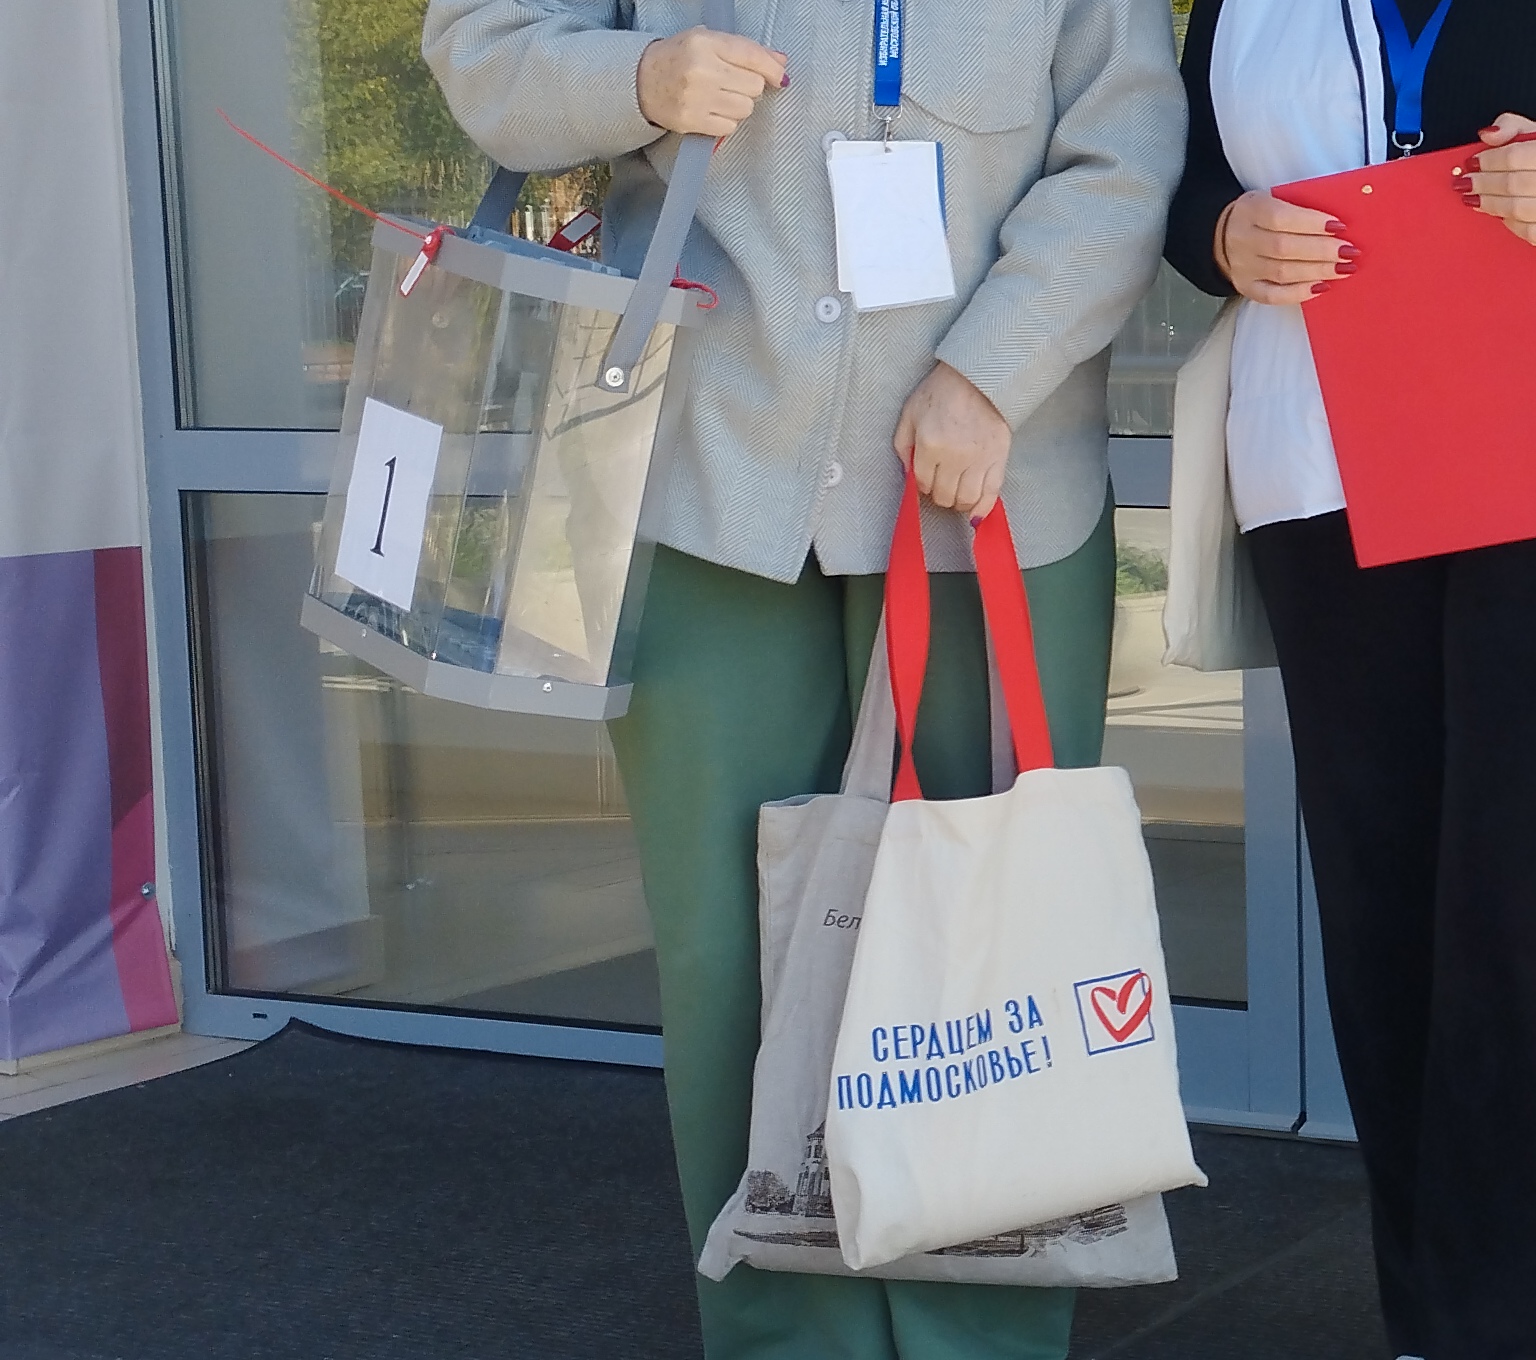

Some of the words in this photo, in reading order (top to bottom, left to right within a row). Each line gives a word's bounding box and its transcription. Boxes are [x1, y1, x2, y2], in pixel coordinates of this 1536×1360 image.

[367, 454, 399, 558] 1
[871, 1006, 994, 1064] СЕРДЦЕМ
[1005, 994, 1045, 1034] ЗА
[835, 1034, 1054, 1111] ПОДМОСКОВЬЕ!
